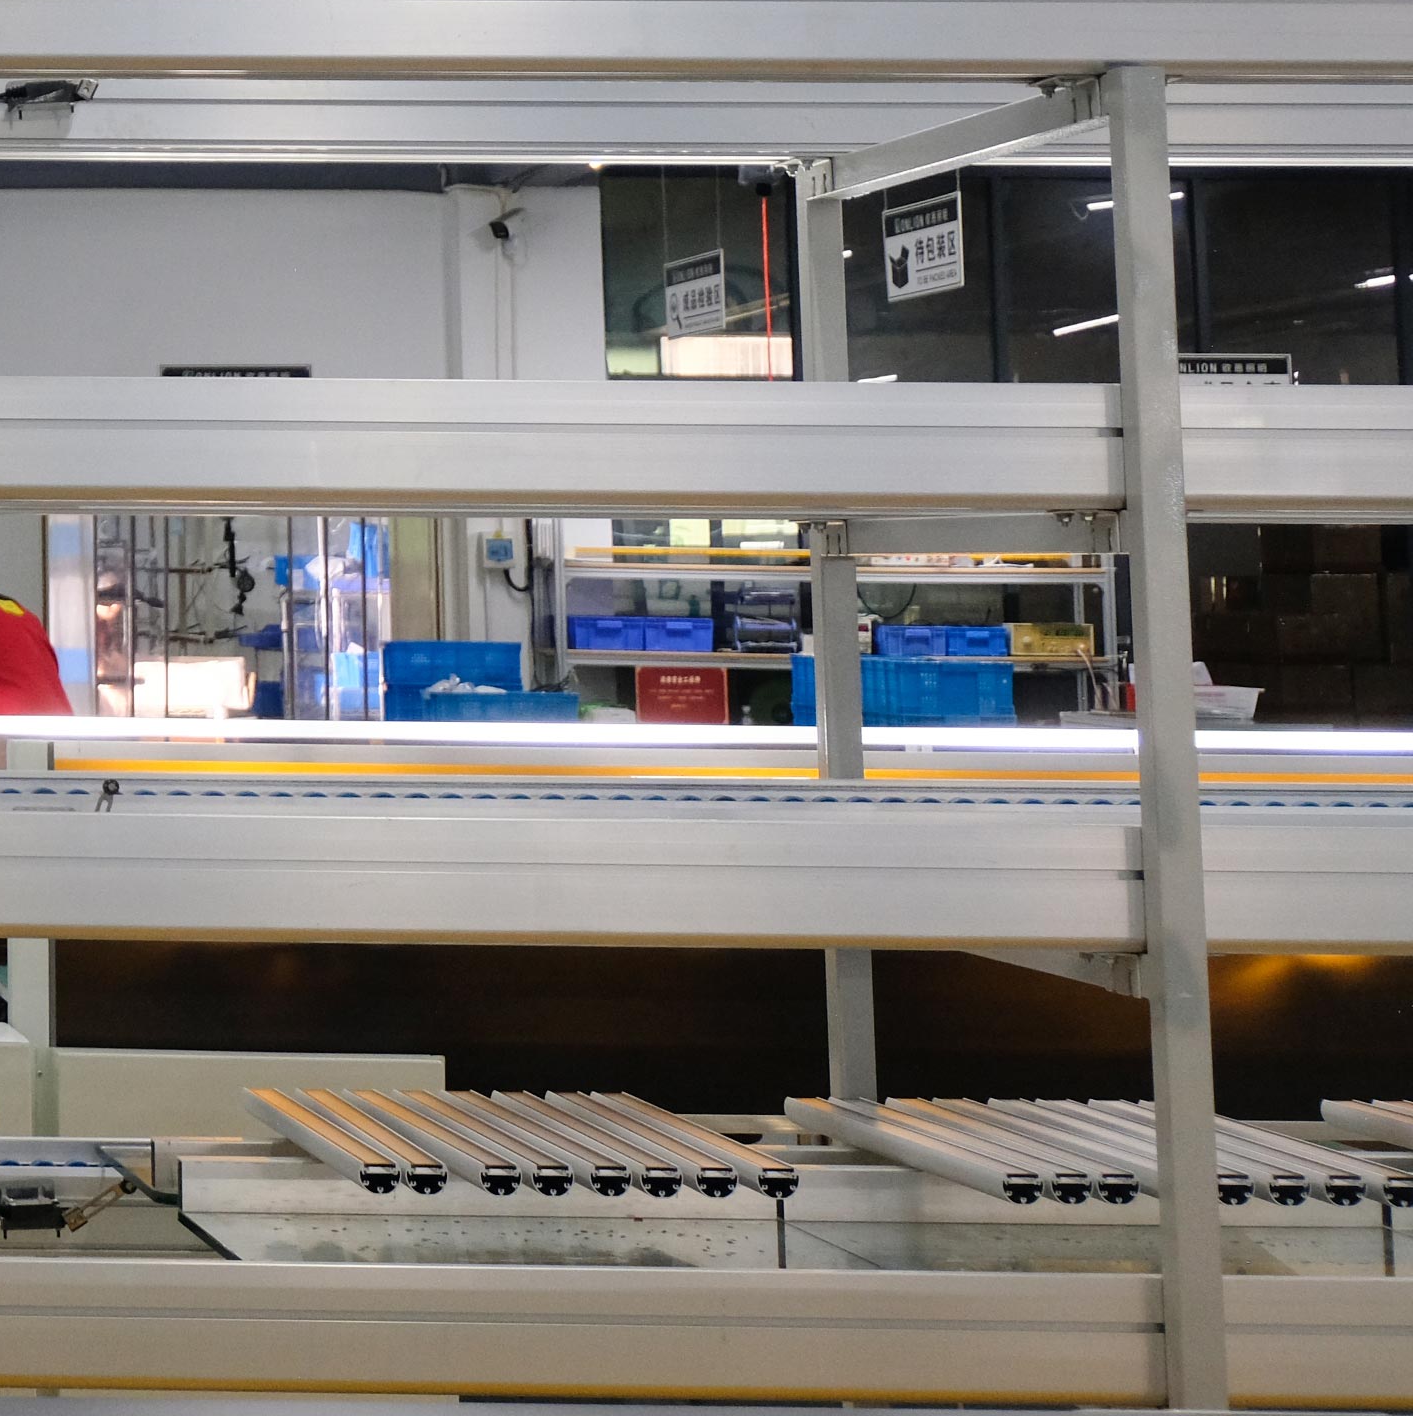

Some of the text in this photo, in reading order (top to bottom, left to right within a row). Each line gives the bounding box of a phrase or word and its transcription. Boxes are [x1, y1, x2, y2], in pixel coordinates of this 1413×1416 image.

[915, 230, 956, 264] 待包装区
[1179, 363, 1217, 372] NLION
